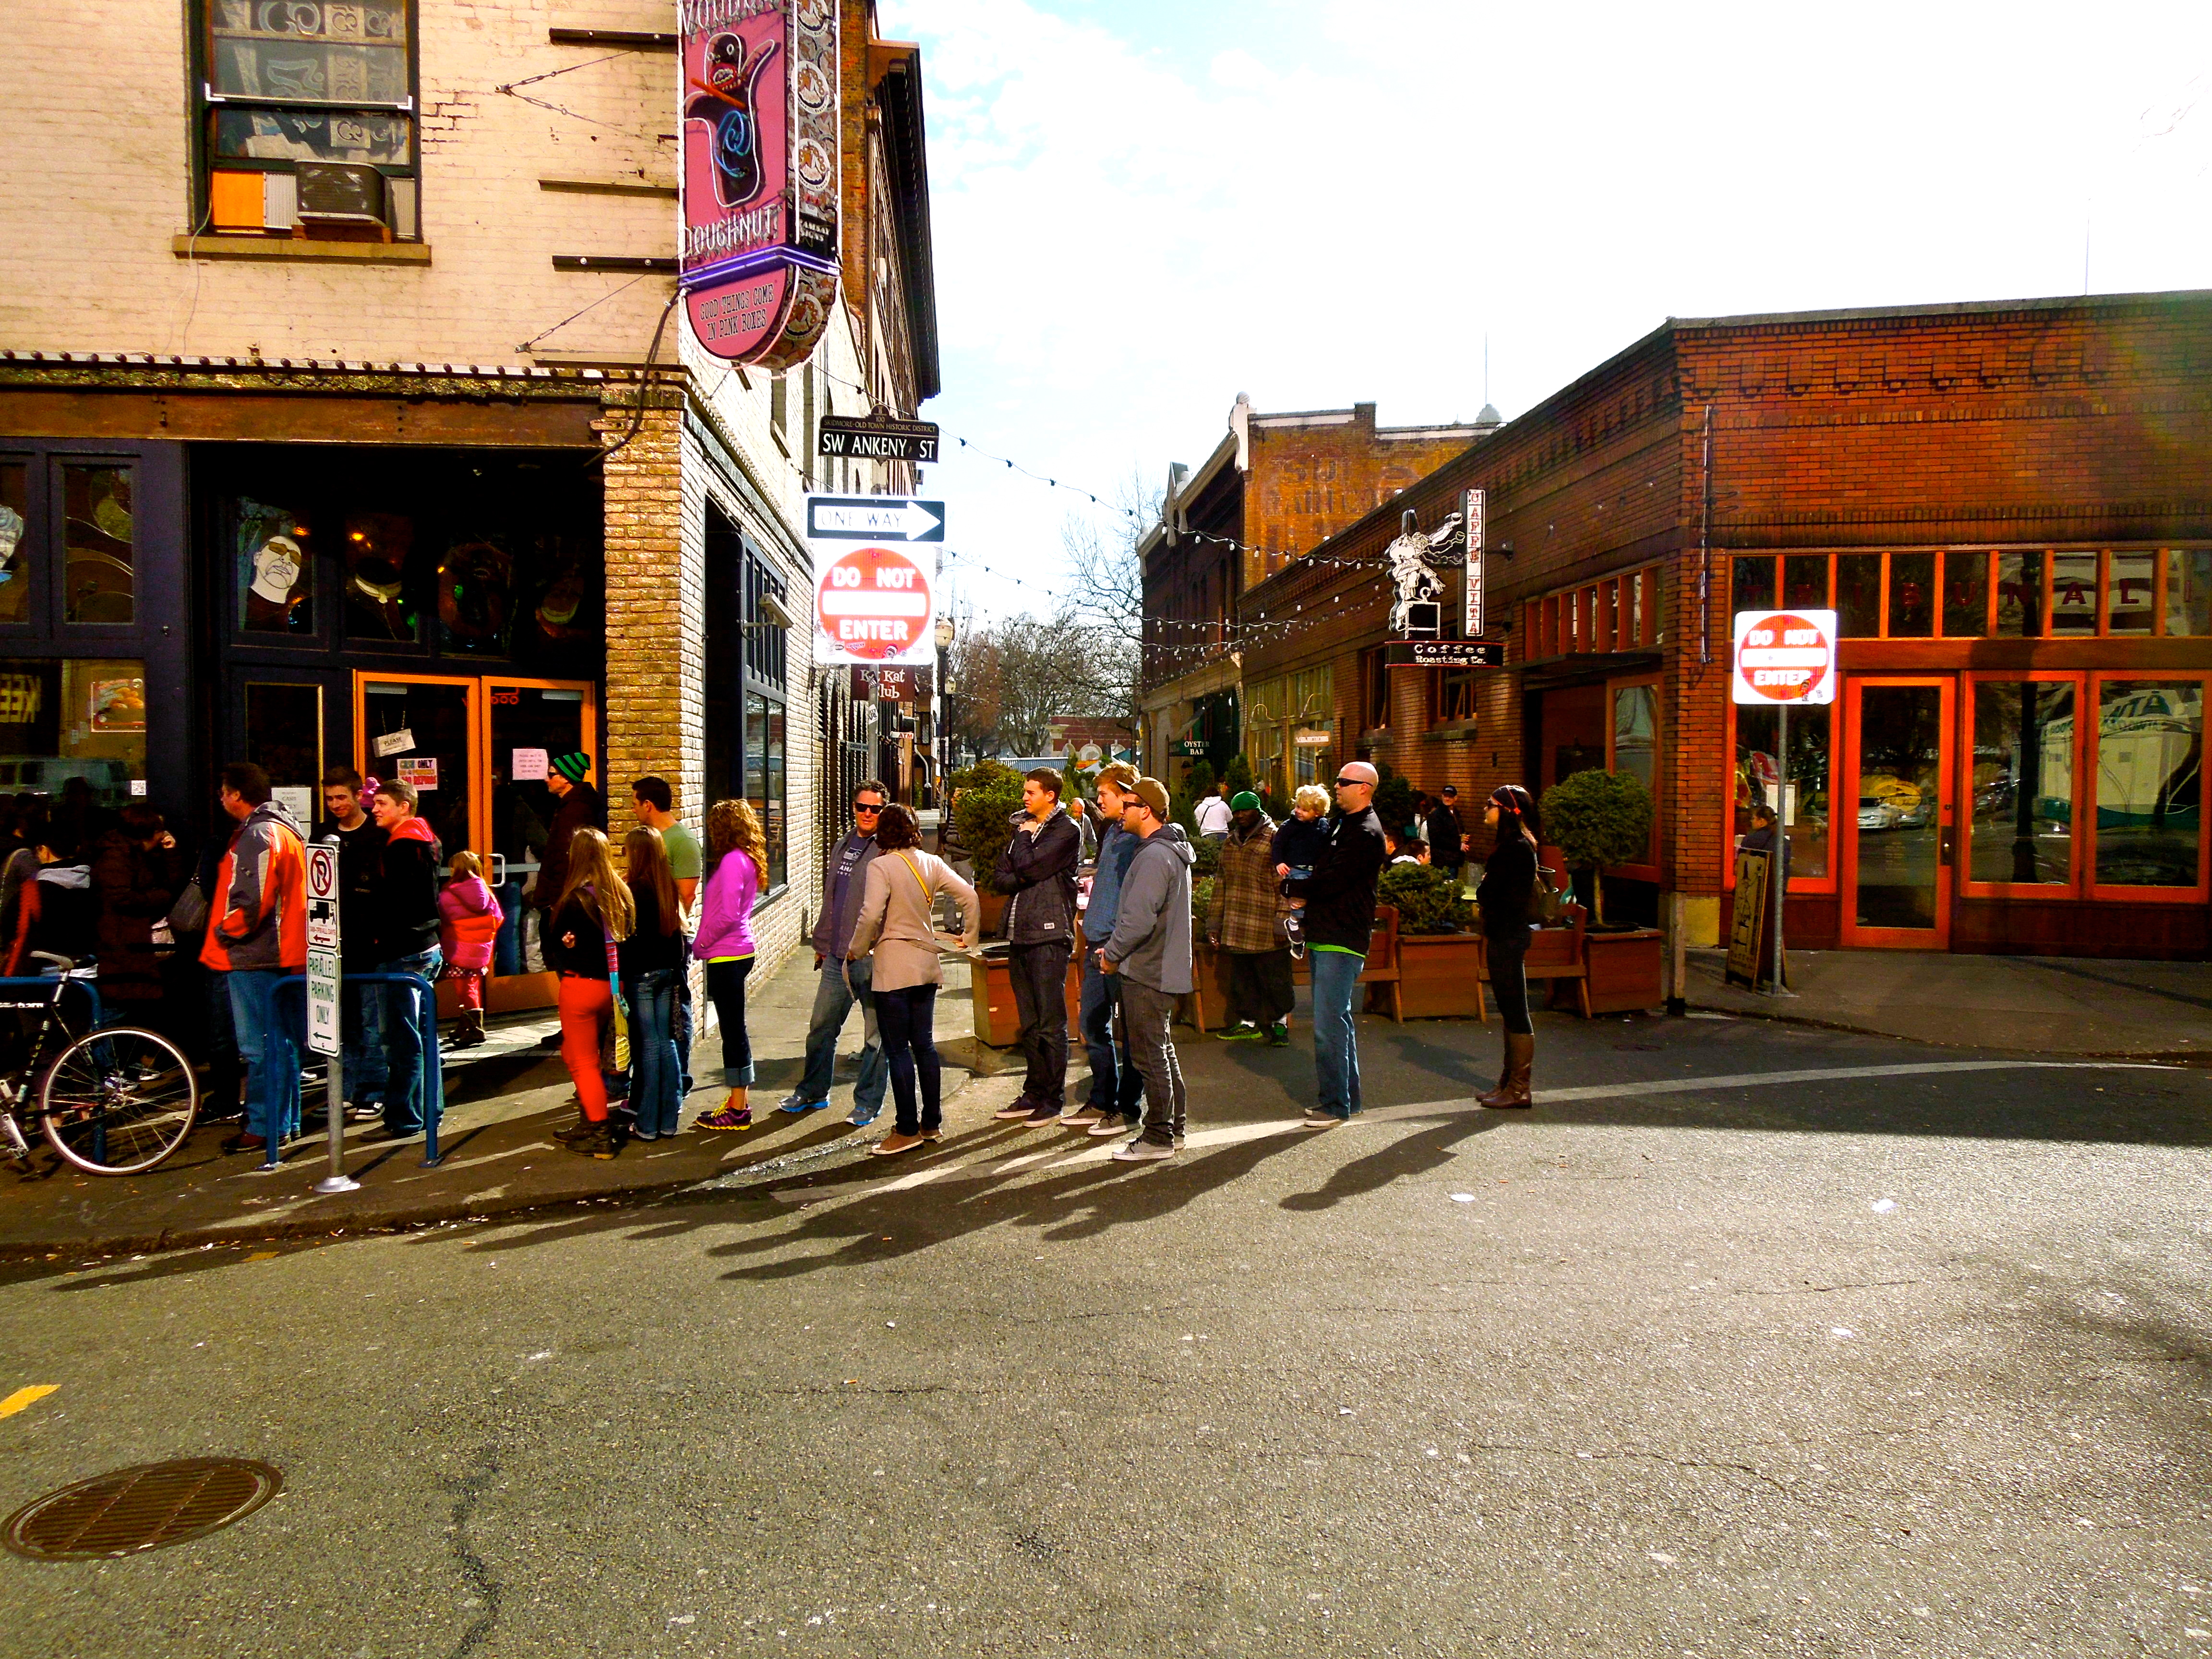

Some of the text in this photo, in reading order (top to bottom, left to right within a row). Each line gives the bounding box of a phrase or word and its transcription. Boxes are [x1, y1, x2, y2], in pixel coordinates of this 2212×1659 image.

[700, 284, 774, 320] GOOD THINGS COME
[707, 309, 766, 340] IN PINK BOXES
[823, 433, 935, 458] SW ANKENY ST
[821, 510, 902, 528] ONE WAY
[832, 567, 915, 588] DO NOT
[1467, 578, 1481, 633] VITA
[840, 620, 908, 641] ENTER
[1749, 629, 1819, 646] DO NOT
[1414, 644, 1486, 654] Coffee
[1416, 655, 1487, 665] Roasting Co.
[884, 669, 905, 683] Kat
[878, 684, 900, 699] lub
[309, 957, 336, 979] PARALLEL
[312, 981, 334, 1003] PARKING
[316, 1004, 330, 1025] ONLY
